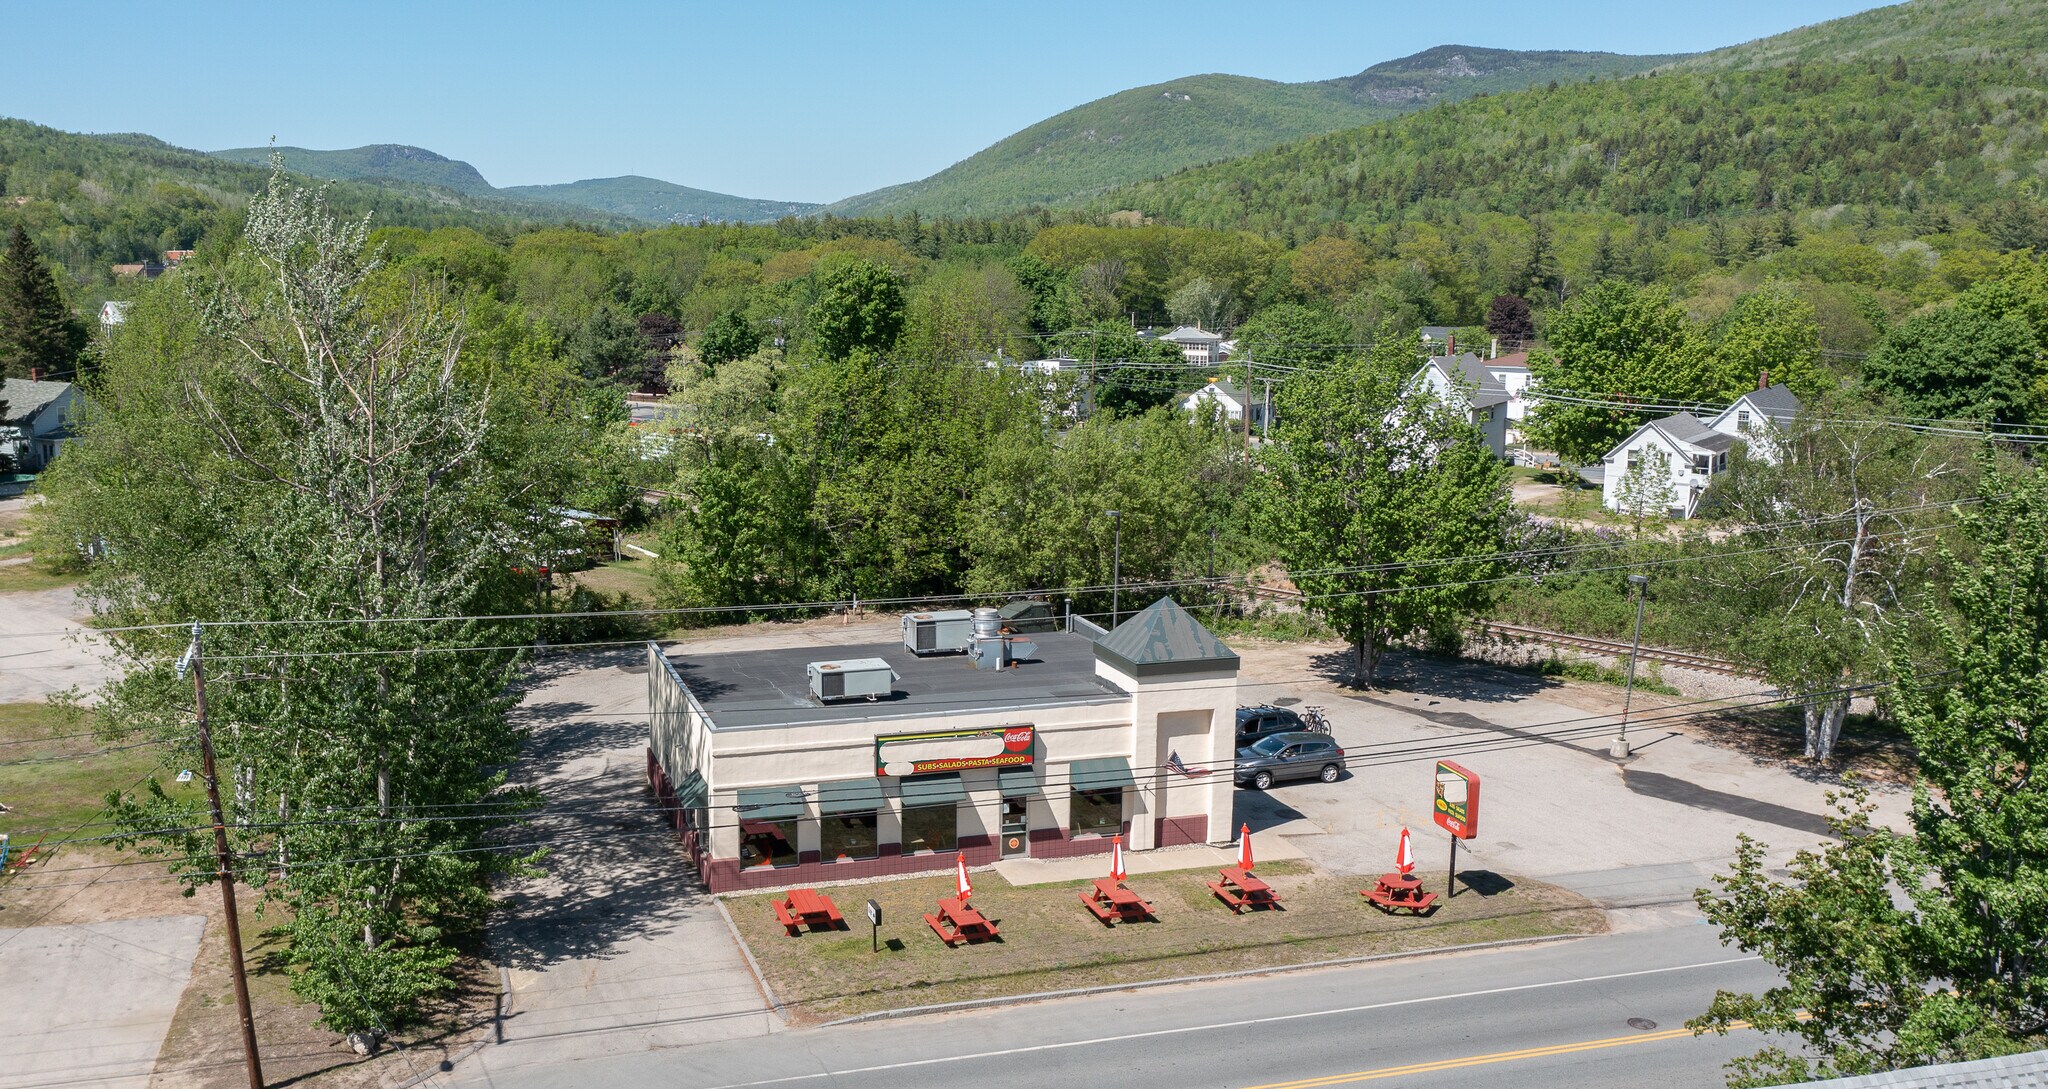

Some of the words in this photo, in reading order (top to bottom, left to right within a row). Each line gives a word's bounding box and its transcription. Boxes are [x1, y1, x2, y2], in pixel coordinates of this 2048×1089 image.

[1004, 731, 1031, 743] Coca-Cola
[917, 763, 936, 771] SUBS
[938, 760, 966, 769] SALADS
[968, 758, 989, 767] PASTA
[992, 756, 1025, 765] SEAFOOD
